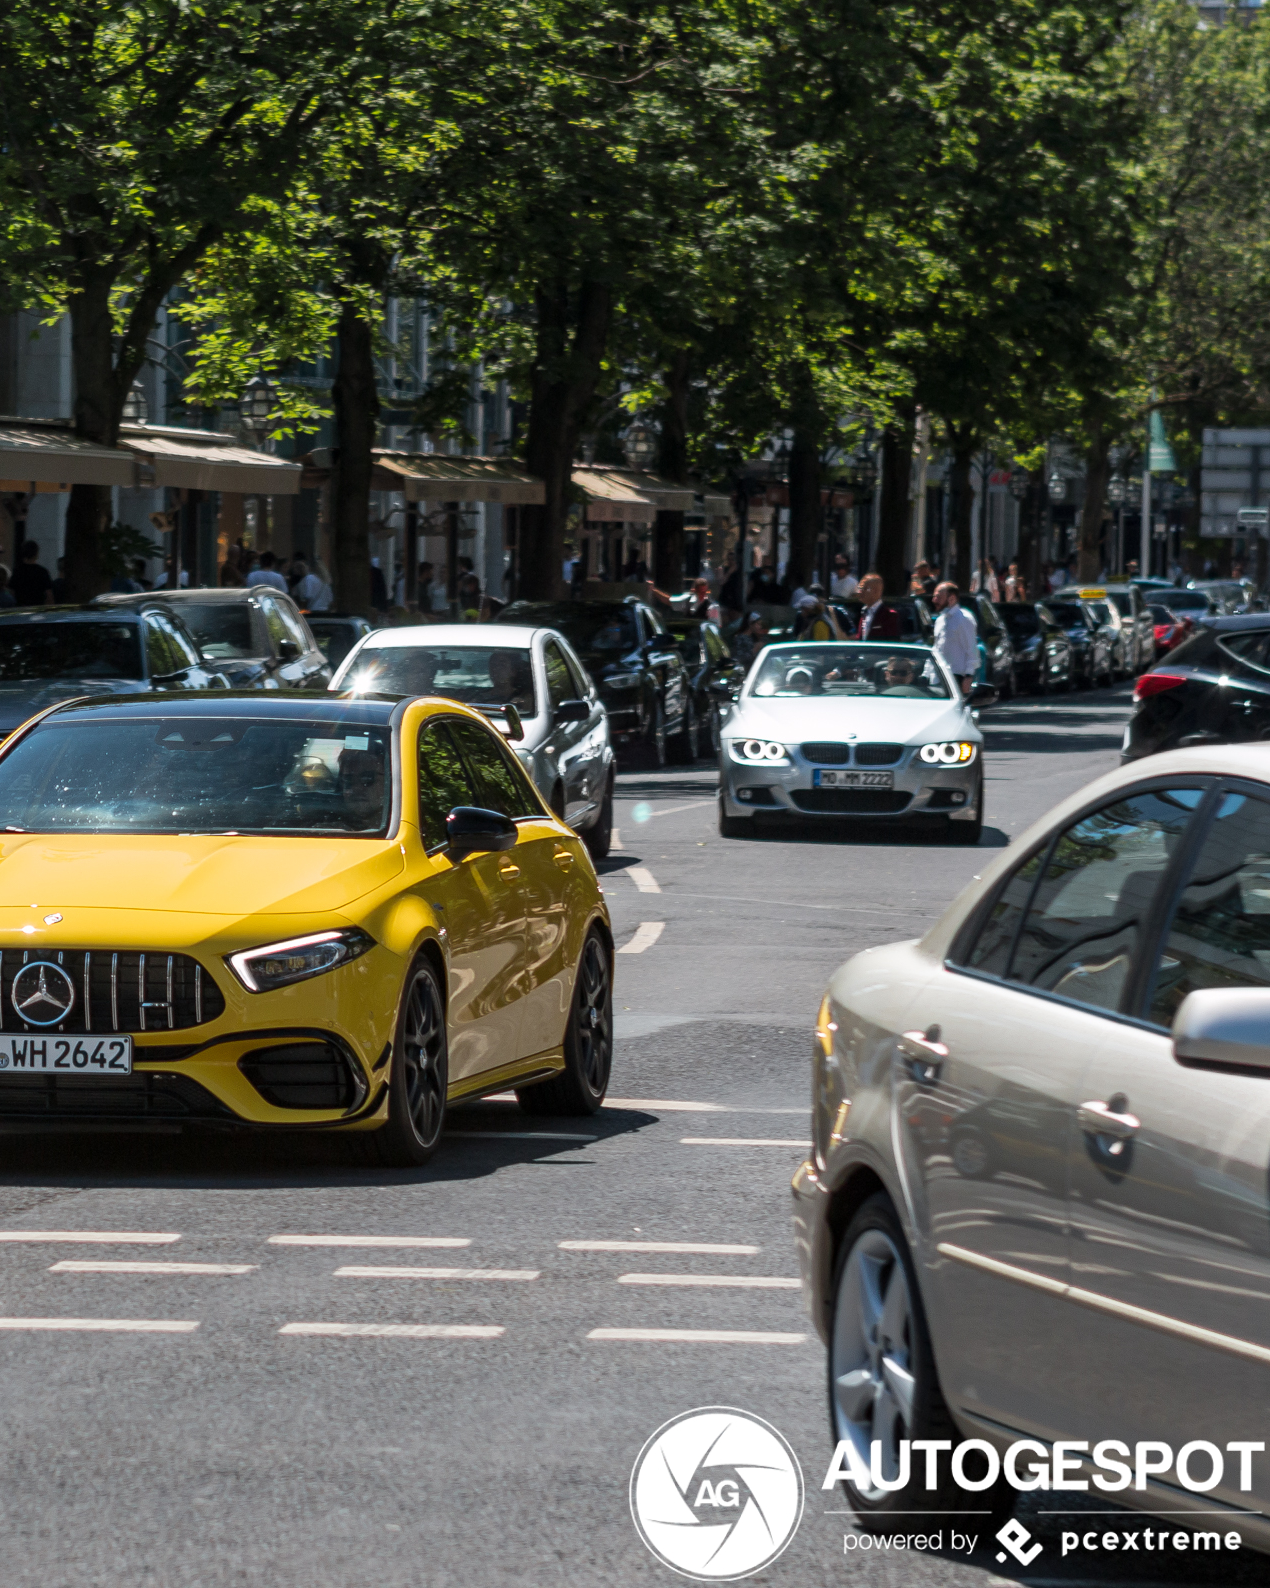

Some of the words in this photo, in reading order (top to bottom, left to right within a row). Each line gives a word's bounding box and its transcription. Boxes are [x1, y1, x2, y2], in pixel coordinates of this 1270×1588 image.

[862, 773, 891, 786] 2222
[11, 1039, 47, 1068] WH
[54, 1040, 126, 1069] 2642
